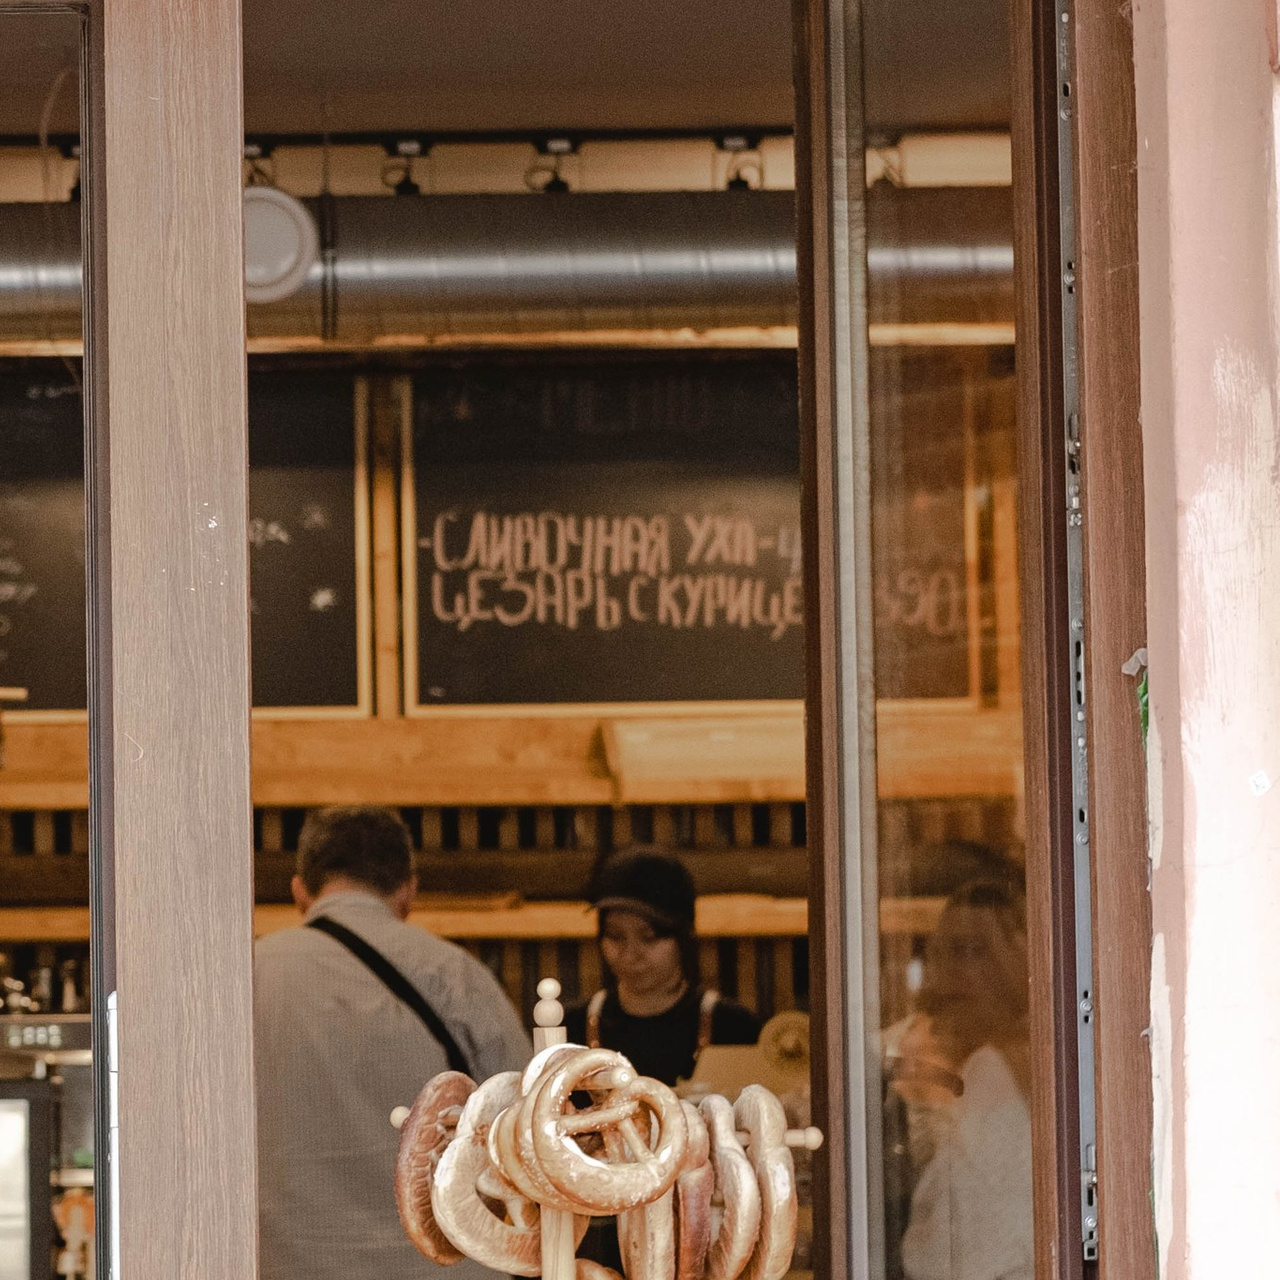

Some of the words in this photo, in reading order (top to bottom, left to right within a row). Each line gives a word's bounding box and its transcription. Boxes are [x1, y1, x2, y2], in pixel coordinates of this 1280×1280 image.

[431, 568, 621, 632] ЦЕЗАРЬ
[628, 575, 650, 622] С
[658, 574, 803, 641] КУРИЦЕ
